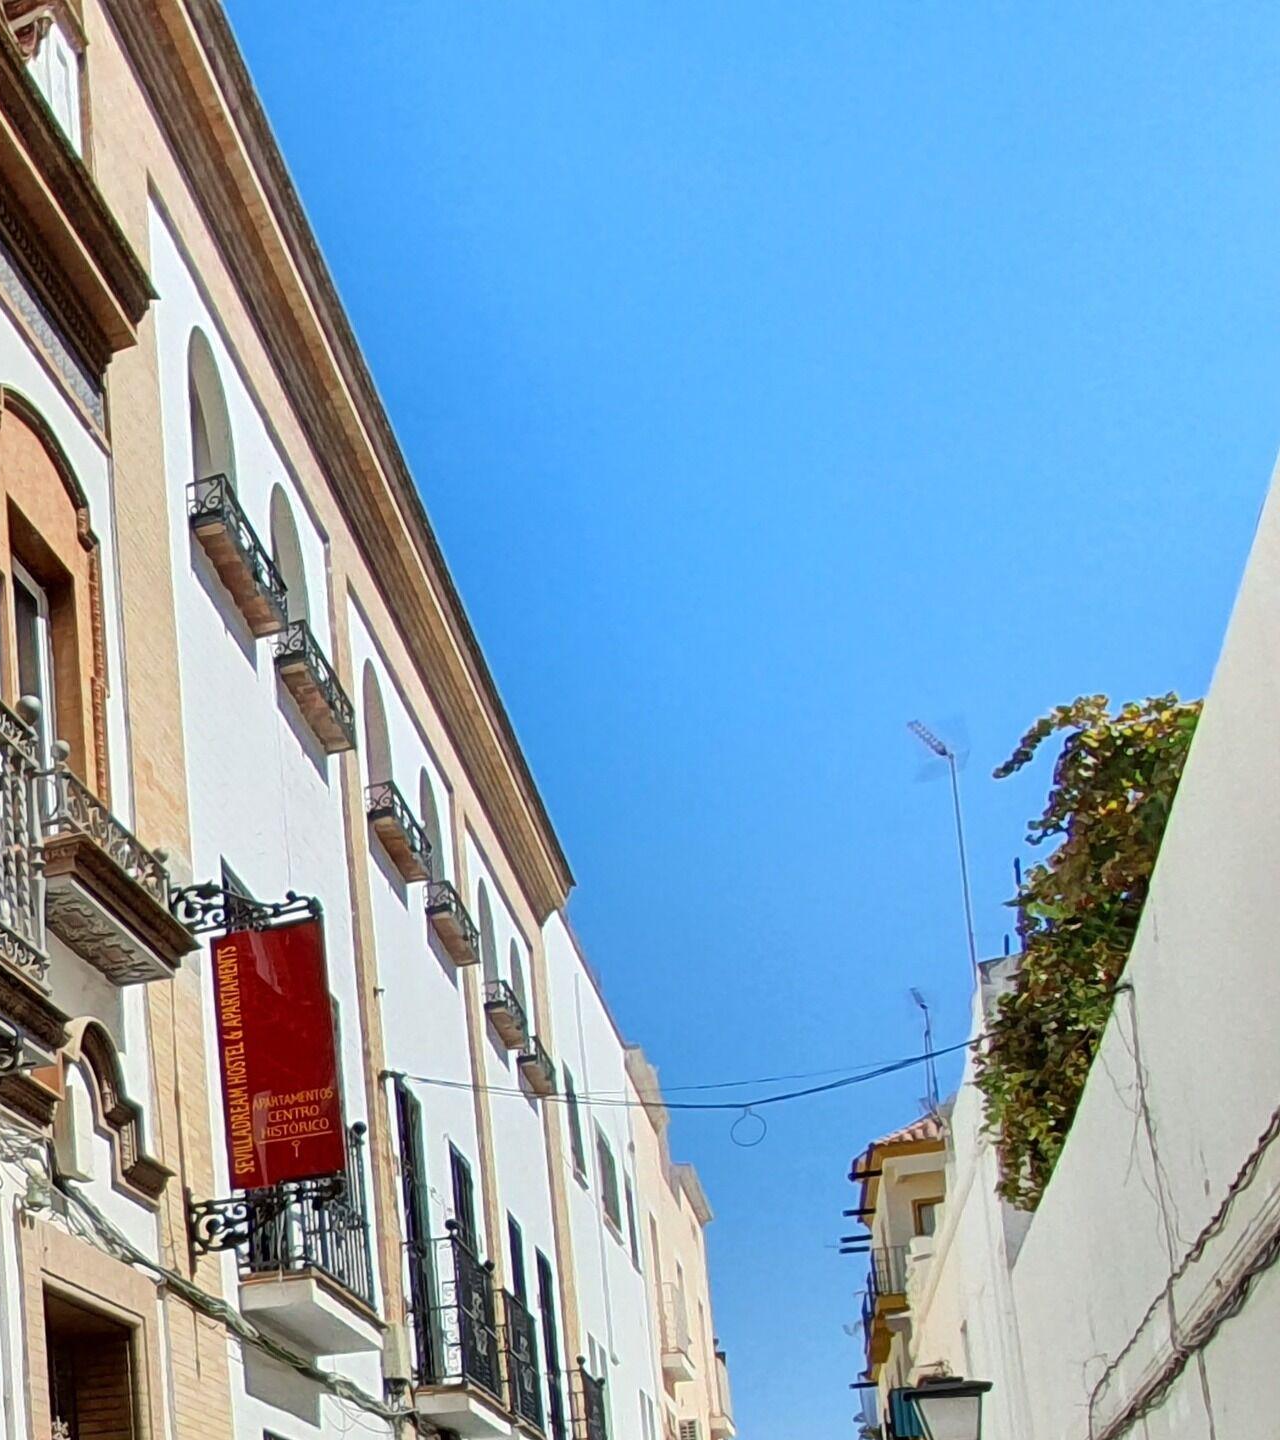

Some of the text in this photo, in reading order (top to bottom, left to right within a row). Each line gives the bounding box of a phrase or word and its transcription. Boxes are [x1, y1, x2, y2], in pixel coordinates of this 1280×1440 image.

[217, 945, 243, 1029] APARTAMENTS
[227, 1041, 248, 1086] HOSTEL
[228, 1086, 255, 1174] SEVILLADREAM
[268, 1104, 320, 1123] CENTRO
